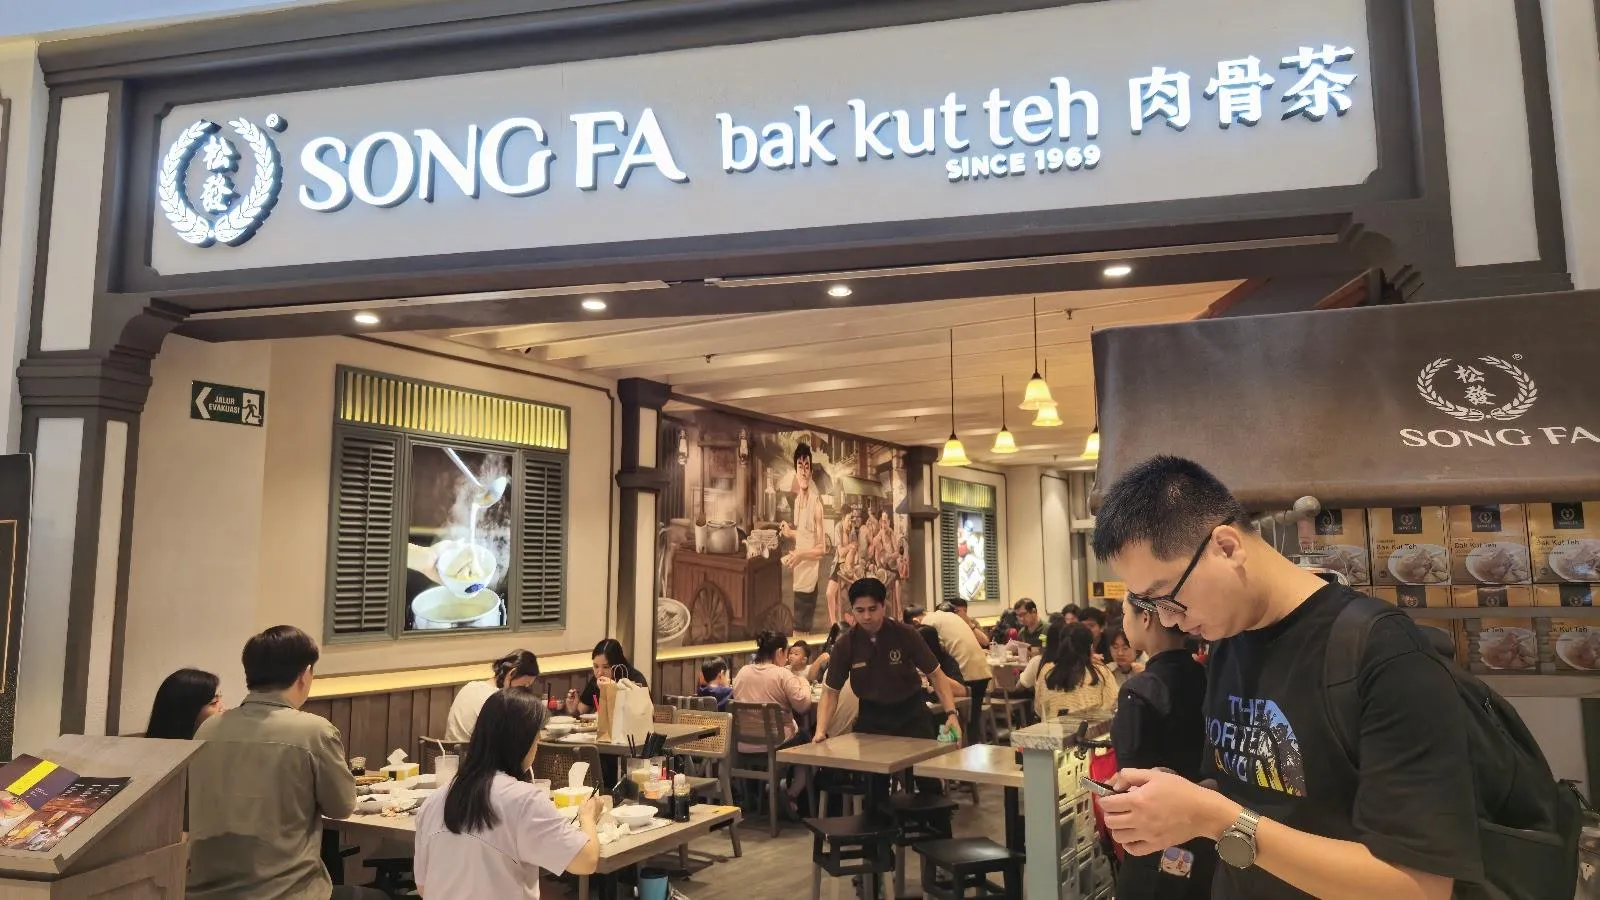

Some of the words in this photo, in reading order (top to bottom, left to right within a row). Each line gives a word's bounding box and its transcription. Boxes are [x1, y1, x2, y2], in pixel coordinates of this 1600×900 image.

[1128, 44, 1357, 132] 肉骨茶
[299, 118, 556, 213] SONG
[570, 107, 689, 191] FA
[716, 104, 838, 172] bak
[847, 92, 969, 161] kut
[983, 76, 1100, 147] teh
[945, 152, 1026, 183] SINCE
[1034, 144, 1102, 174] 1969
[208, 403, 240, 414] EVAKUASI
[214, 395, 235, 406] JALUR
[1399, 428, 1532, 448] SONG
[1537, 426, 1600, 445] FA
[1228, 695, 1266, 726] THE
